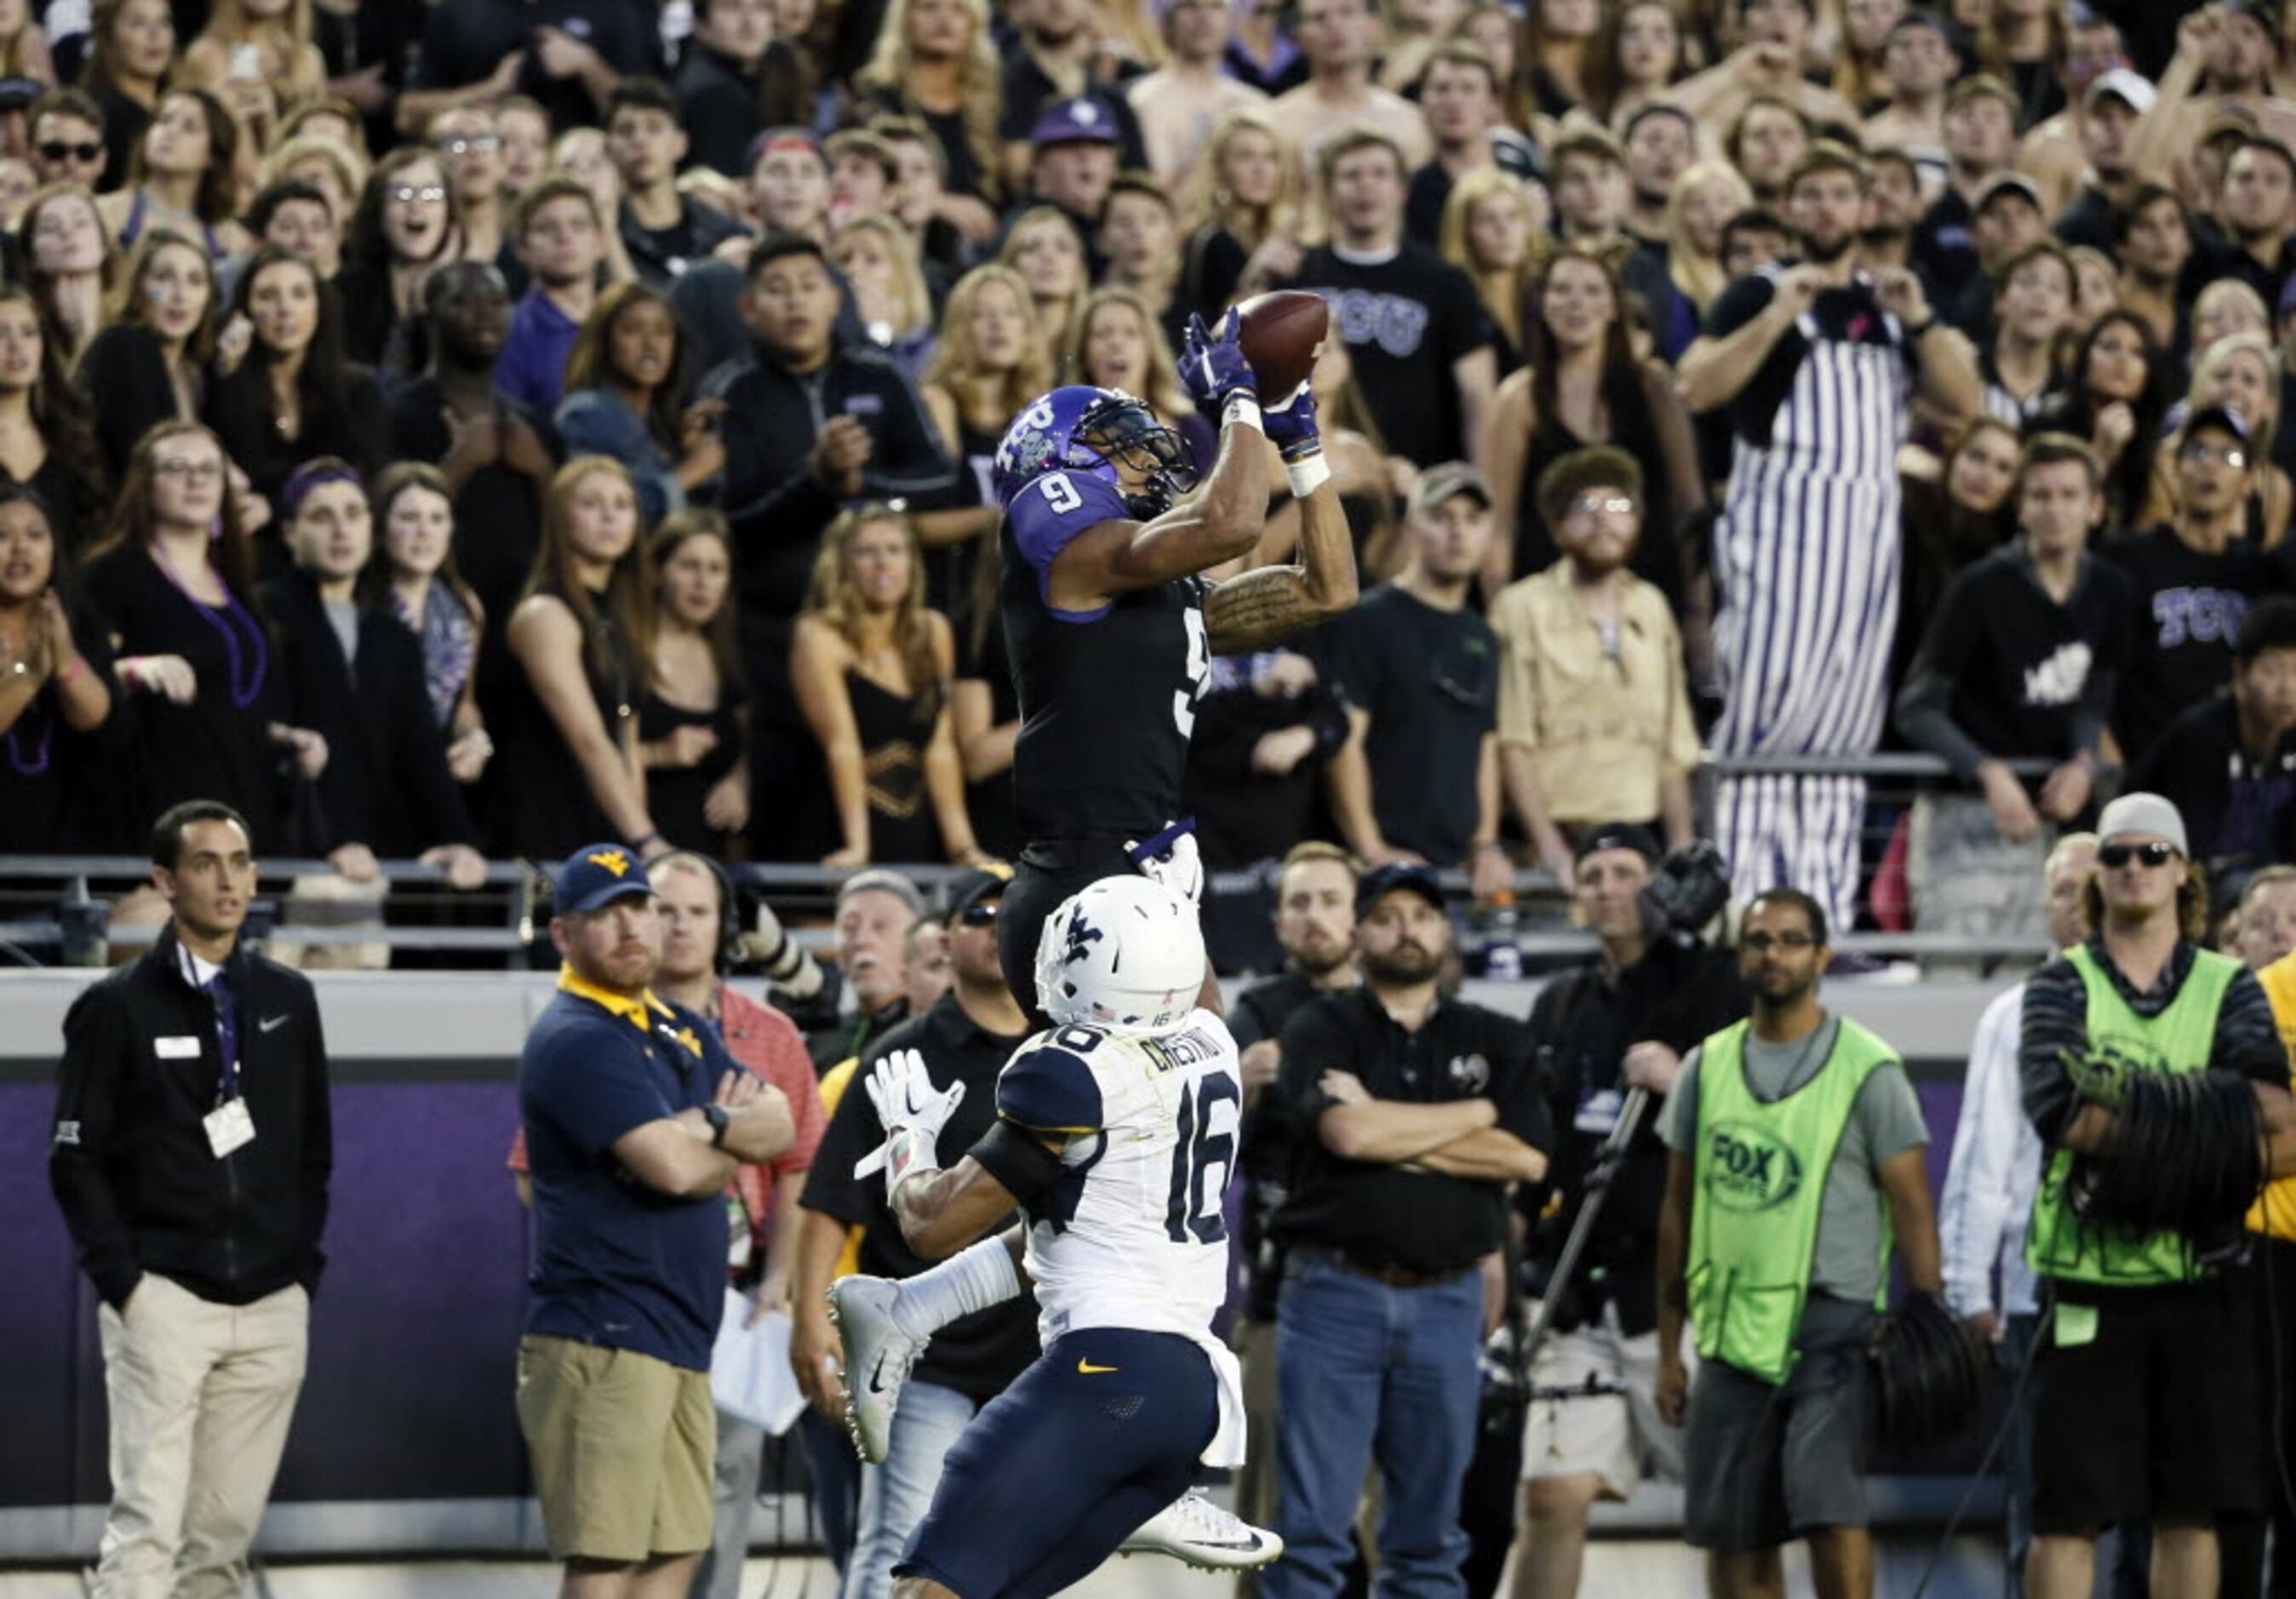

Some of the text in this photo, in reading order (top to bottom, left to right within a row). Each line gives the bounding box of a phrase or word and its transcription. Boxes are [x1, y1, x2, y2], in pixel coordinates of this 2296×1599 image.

[1039, 472, 1083, 514] 9
[1151, 1011, 1171, 1027] 16
[1164, 1069, 1240, 1245] 16
[1713, 1133, 1775, 1183] FOX
